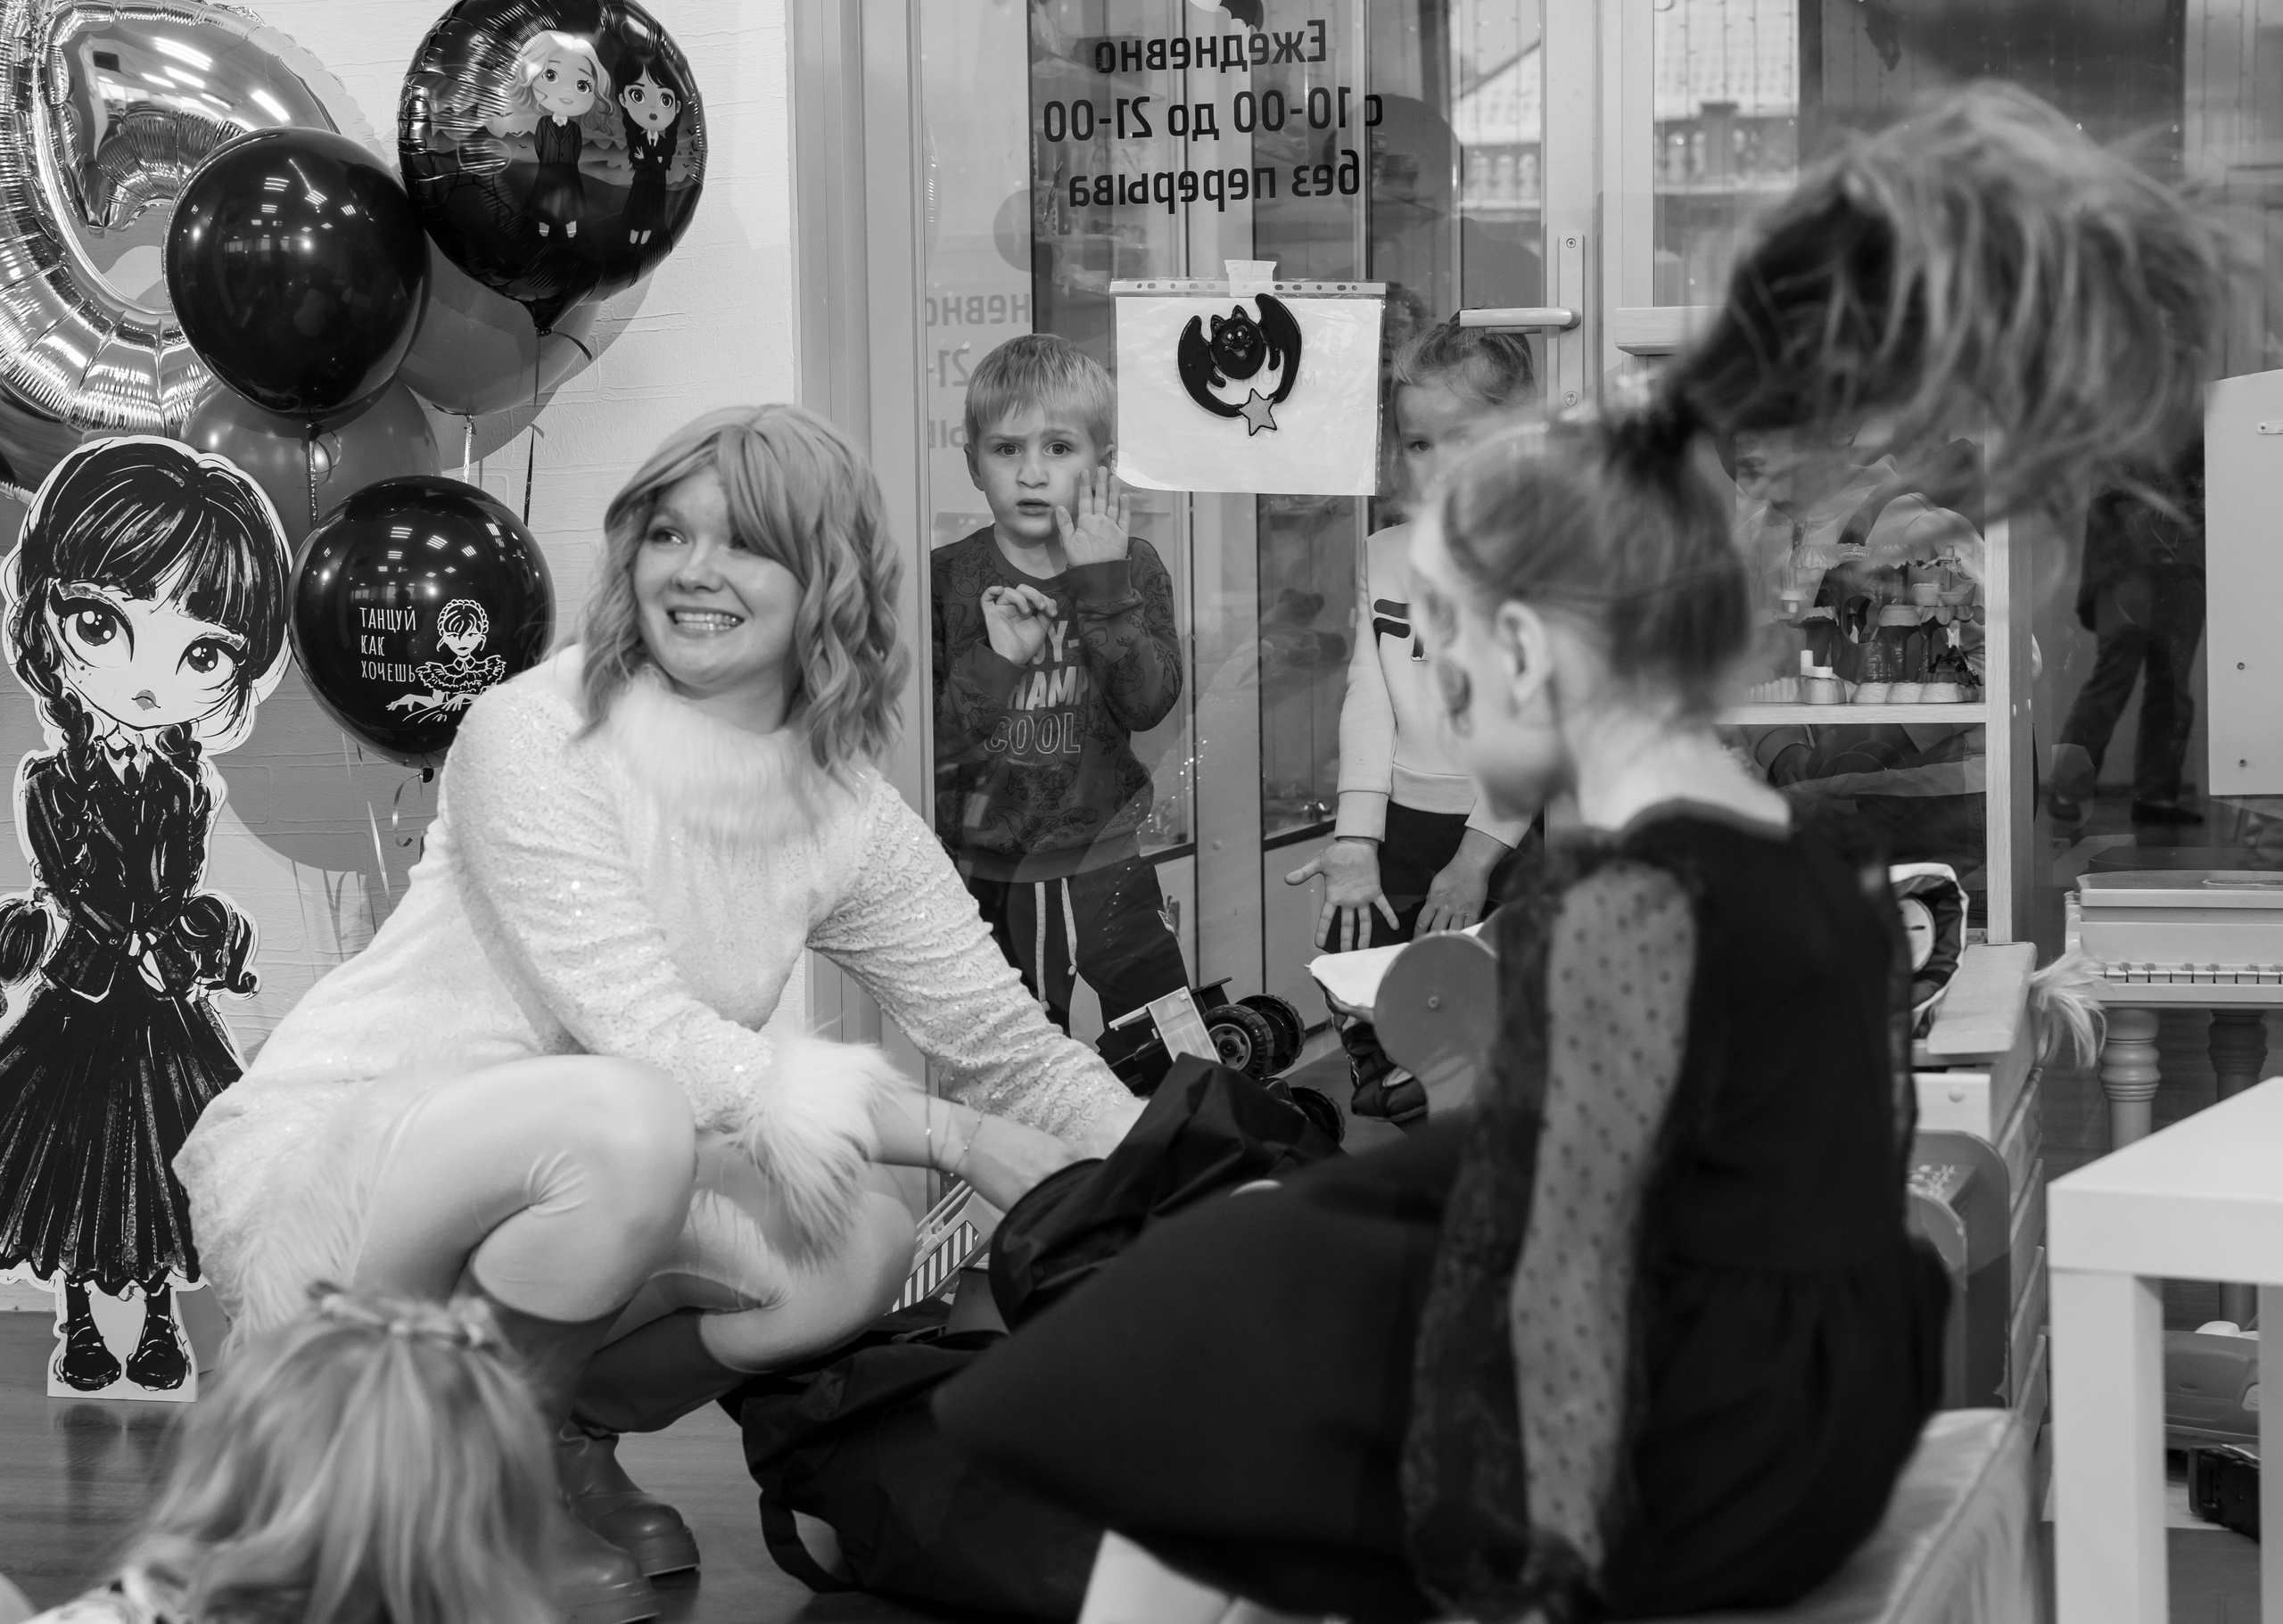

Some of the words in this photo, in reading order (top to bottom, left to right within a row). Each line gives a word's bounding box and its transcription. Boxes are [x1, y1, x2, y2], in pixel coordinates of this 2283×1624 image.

[359, 606, 416, 634] ТАНЦУЙ
[360, 634, 385, 656] КАК
[360, 660, 416, 683] ХОЧЕШЬ
[984, 712, 1081, 755] COOL
